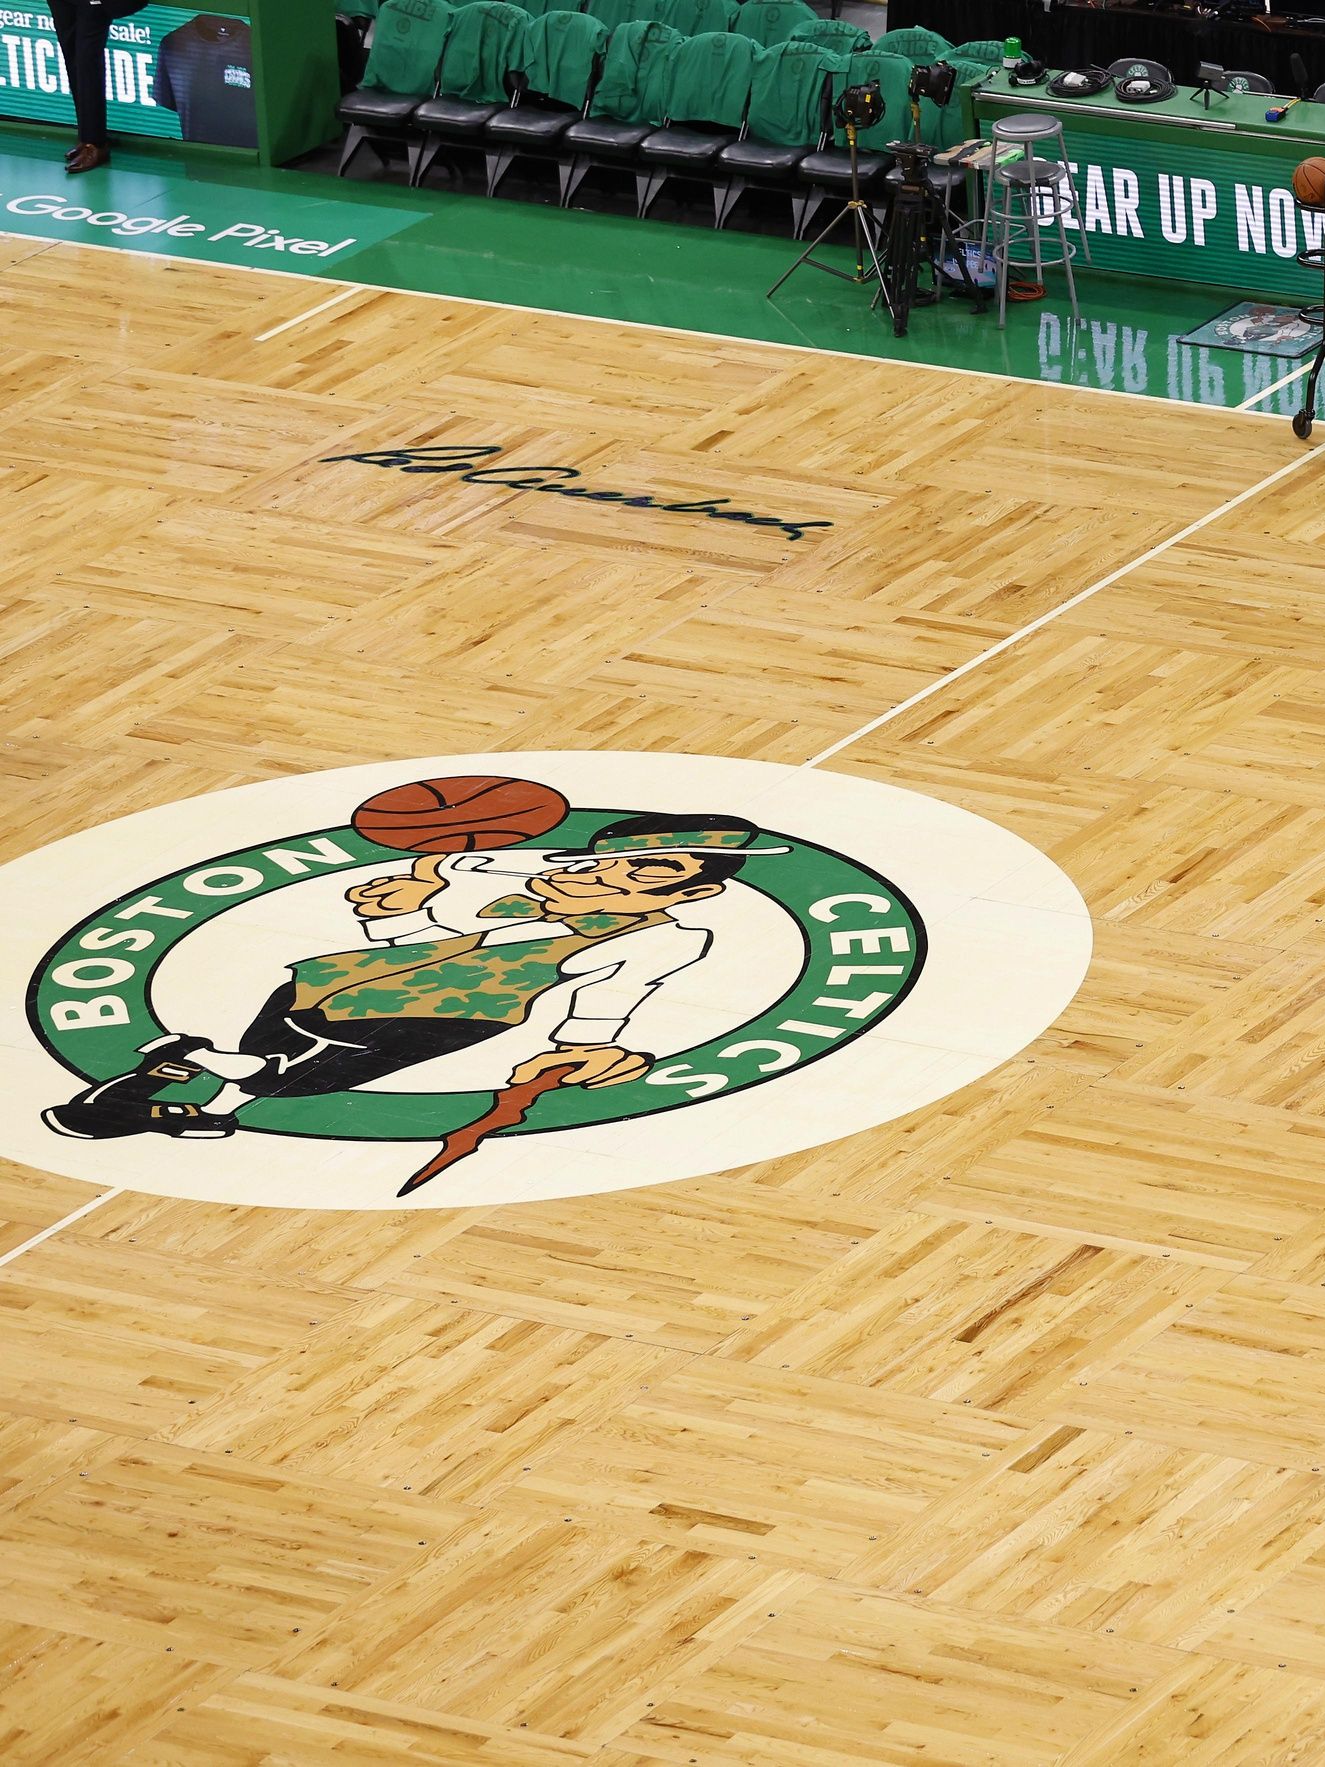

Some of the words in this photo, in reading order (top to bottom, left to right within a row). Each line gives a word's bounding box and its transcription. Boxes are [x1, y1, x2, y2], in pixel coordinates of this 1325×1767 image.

[109, 23, 152, 44] sale!
[6, 195, 206, 237] Google
[207, 222, 357, 258] Pixel
[1157, 173, 1217, 247] UP
[56, 837, 355, 1031] BOSTON
[644, 891, 912, 1100] CELTICS
